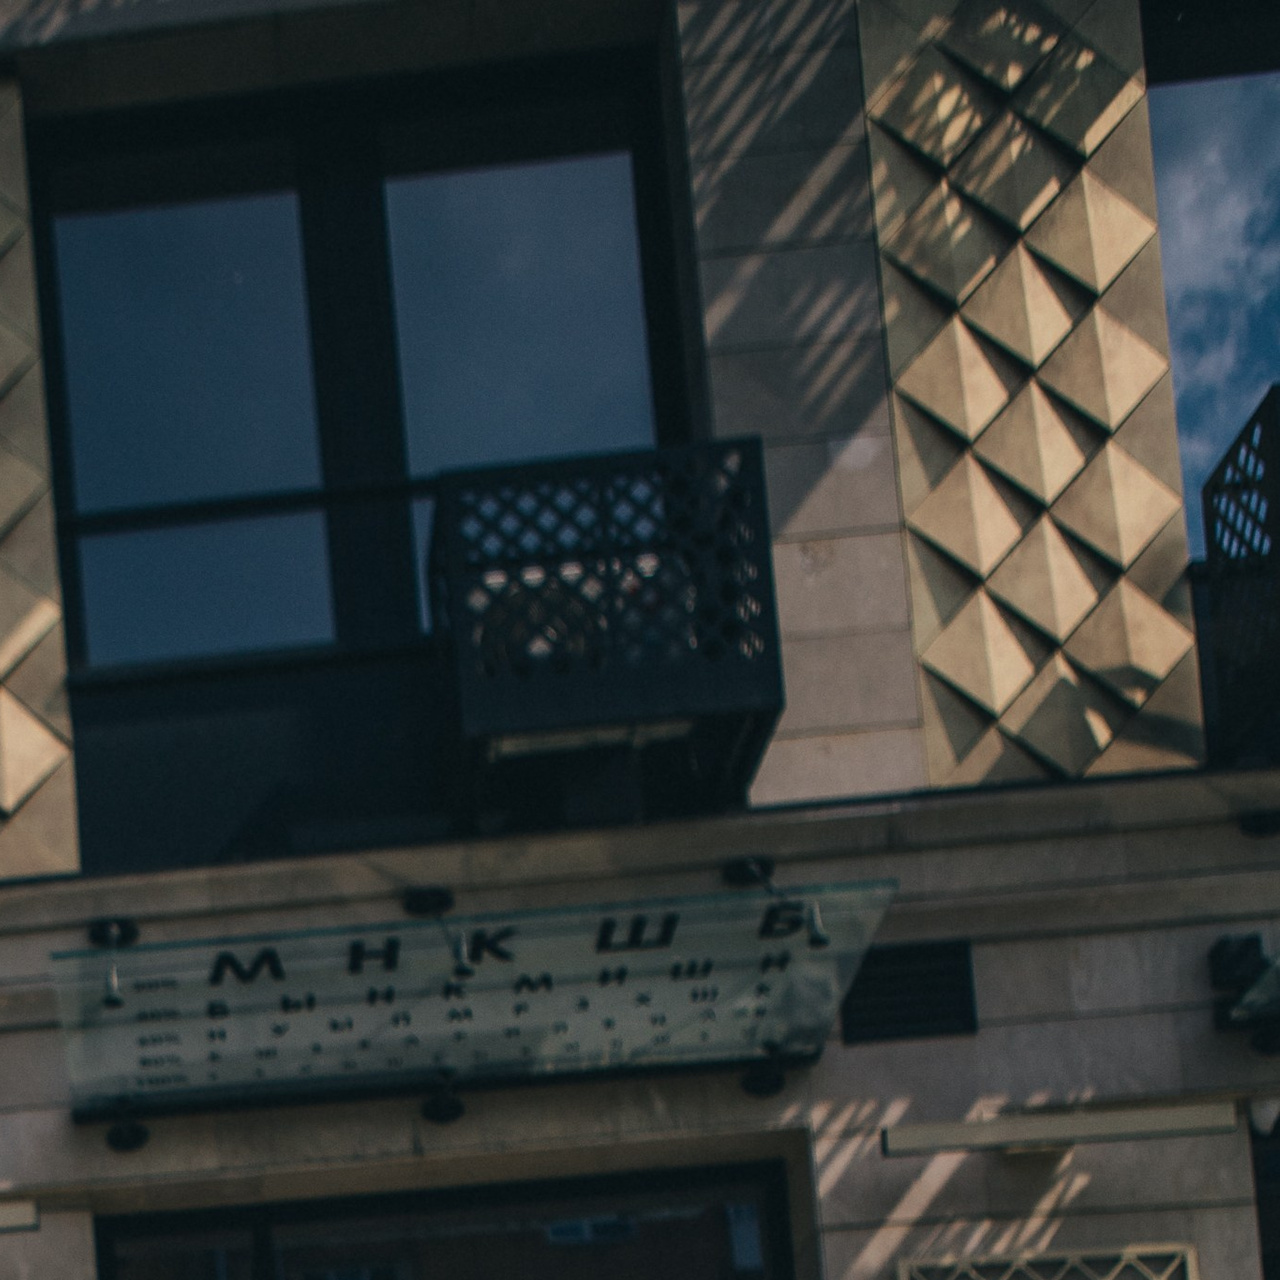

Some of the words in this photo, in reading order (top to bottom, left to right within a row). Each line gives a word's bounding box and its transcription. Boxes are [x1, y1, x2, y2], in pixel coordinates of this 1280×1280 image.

[210, 947, 285, 986] М
[348, 936, 400, 974] Н
[468, 926, 517, 964] К
[596, 912, 680, 954] Ш
